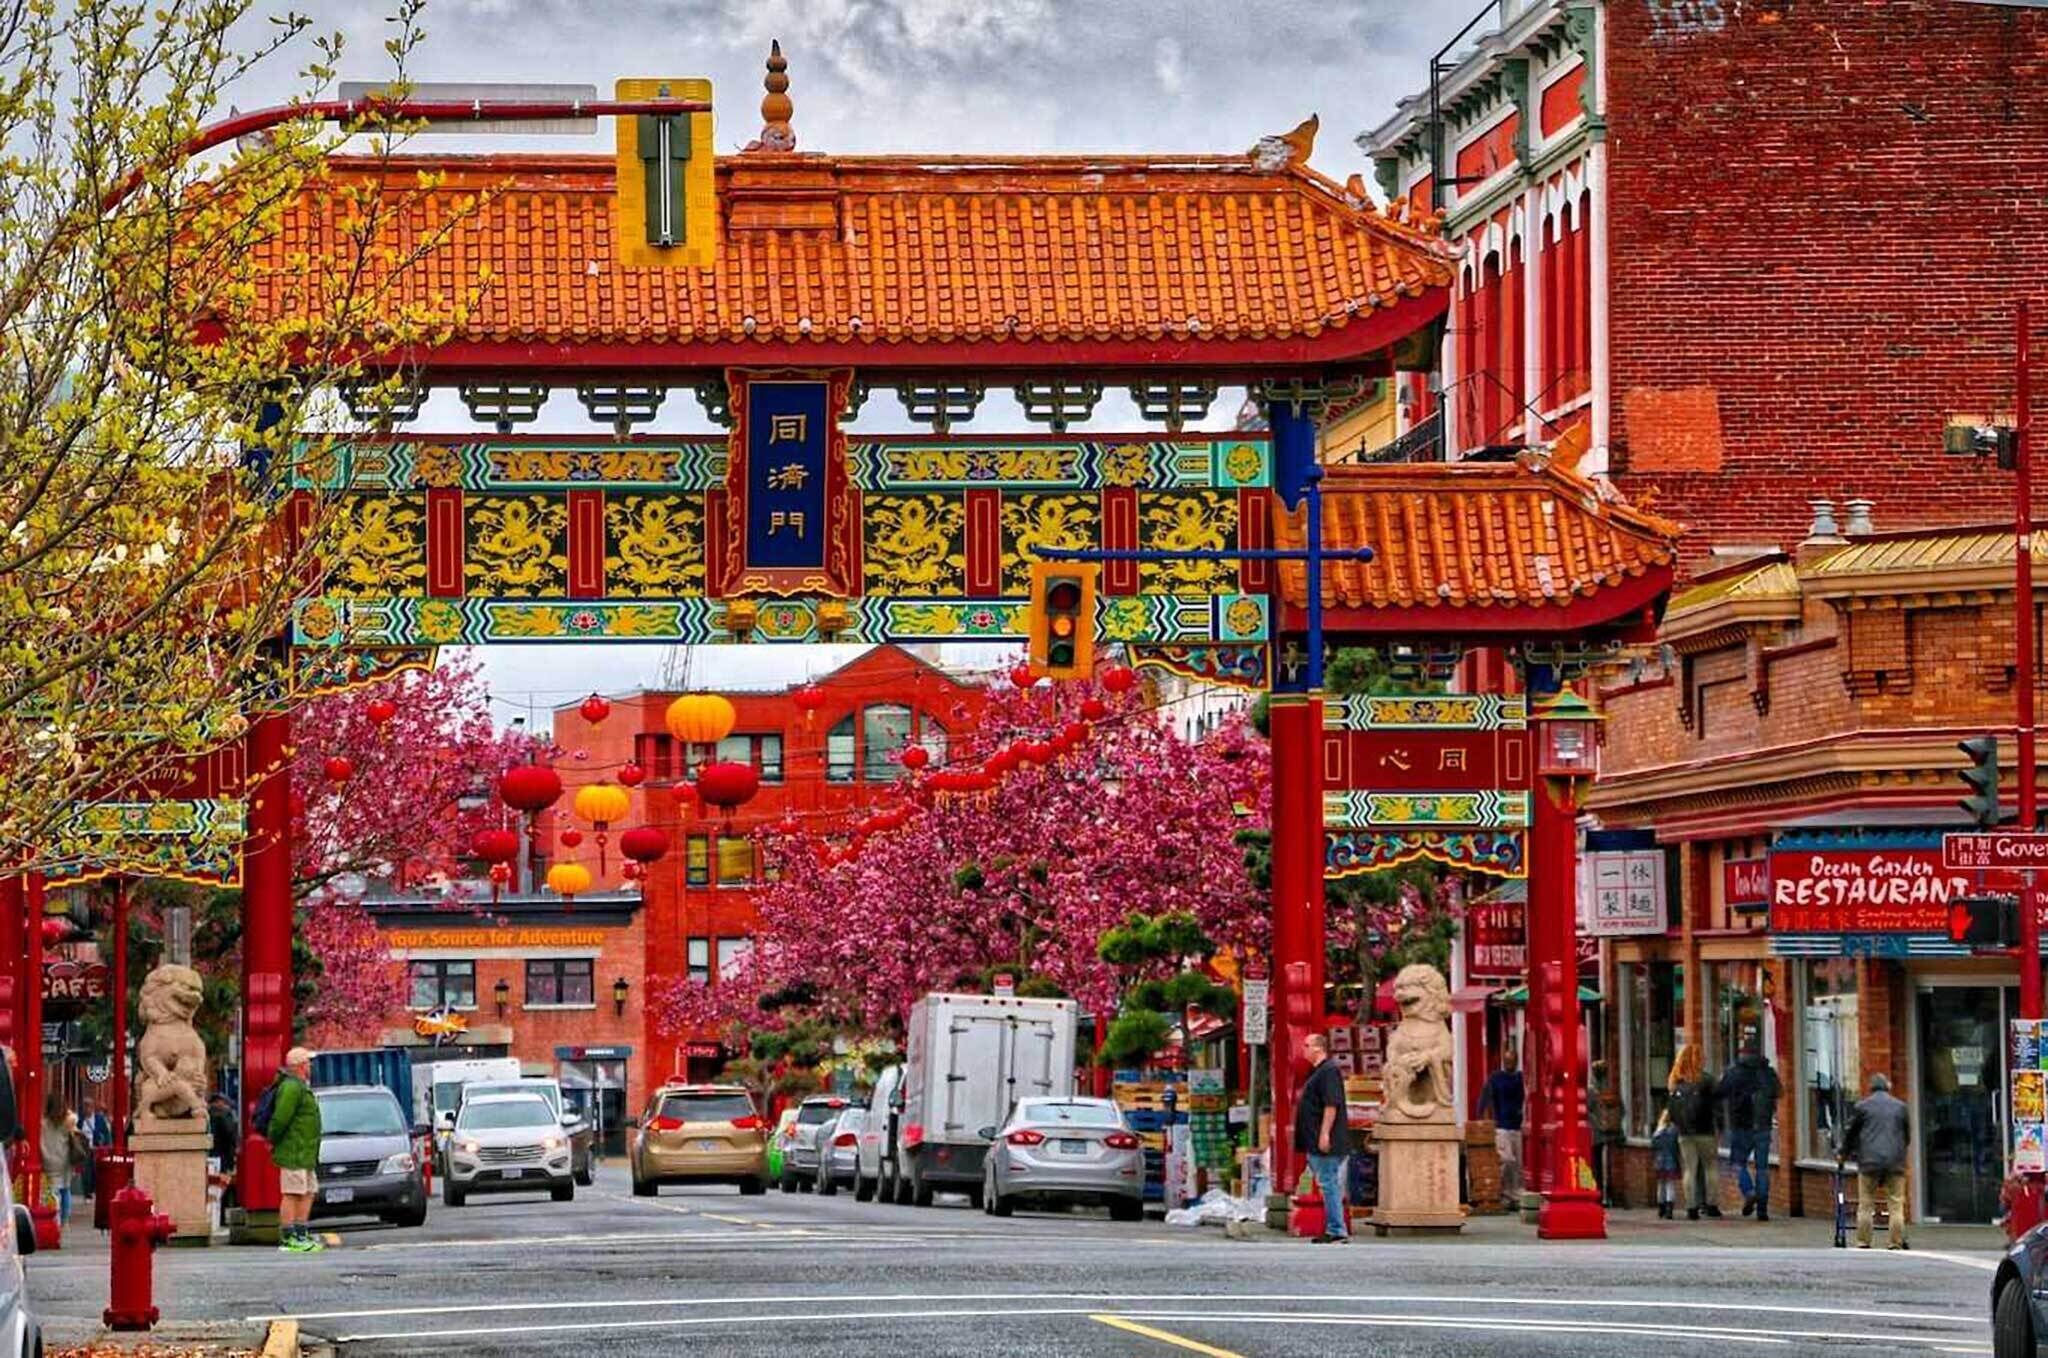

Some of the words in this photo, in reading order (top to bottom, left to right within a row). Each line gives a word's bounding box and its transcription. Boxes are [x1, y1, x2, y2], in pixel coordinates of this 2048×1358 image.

[767, 412, 810, 540] 同濟門
[1810, 856, 1862, 877] Ocean
[1868, 855, 1934, 877] Garden
[1774, 876, 1970, 906] RESTAURANT
[430, 930, 485, 946] Source
[489, 929, 515, 945] for
[519, 929, 603, 946] Adventure
